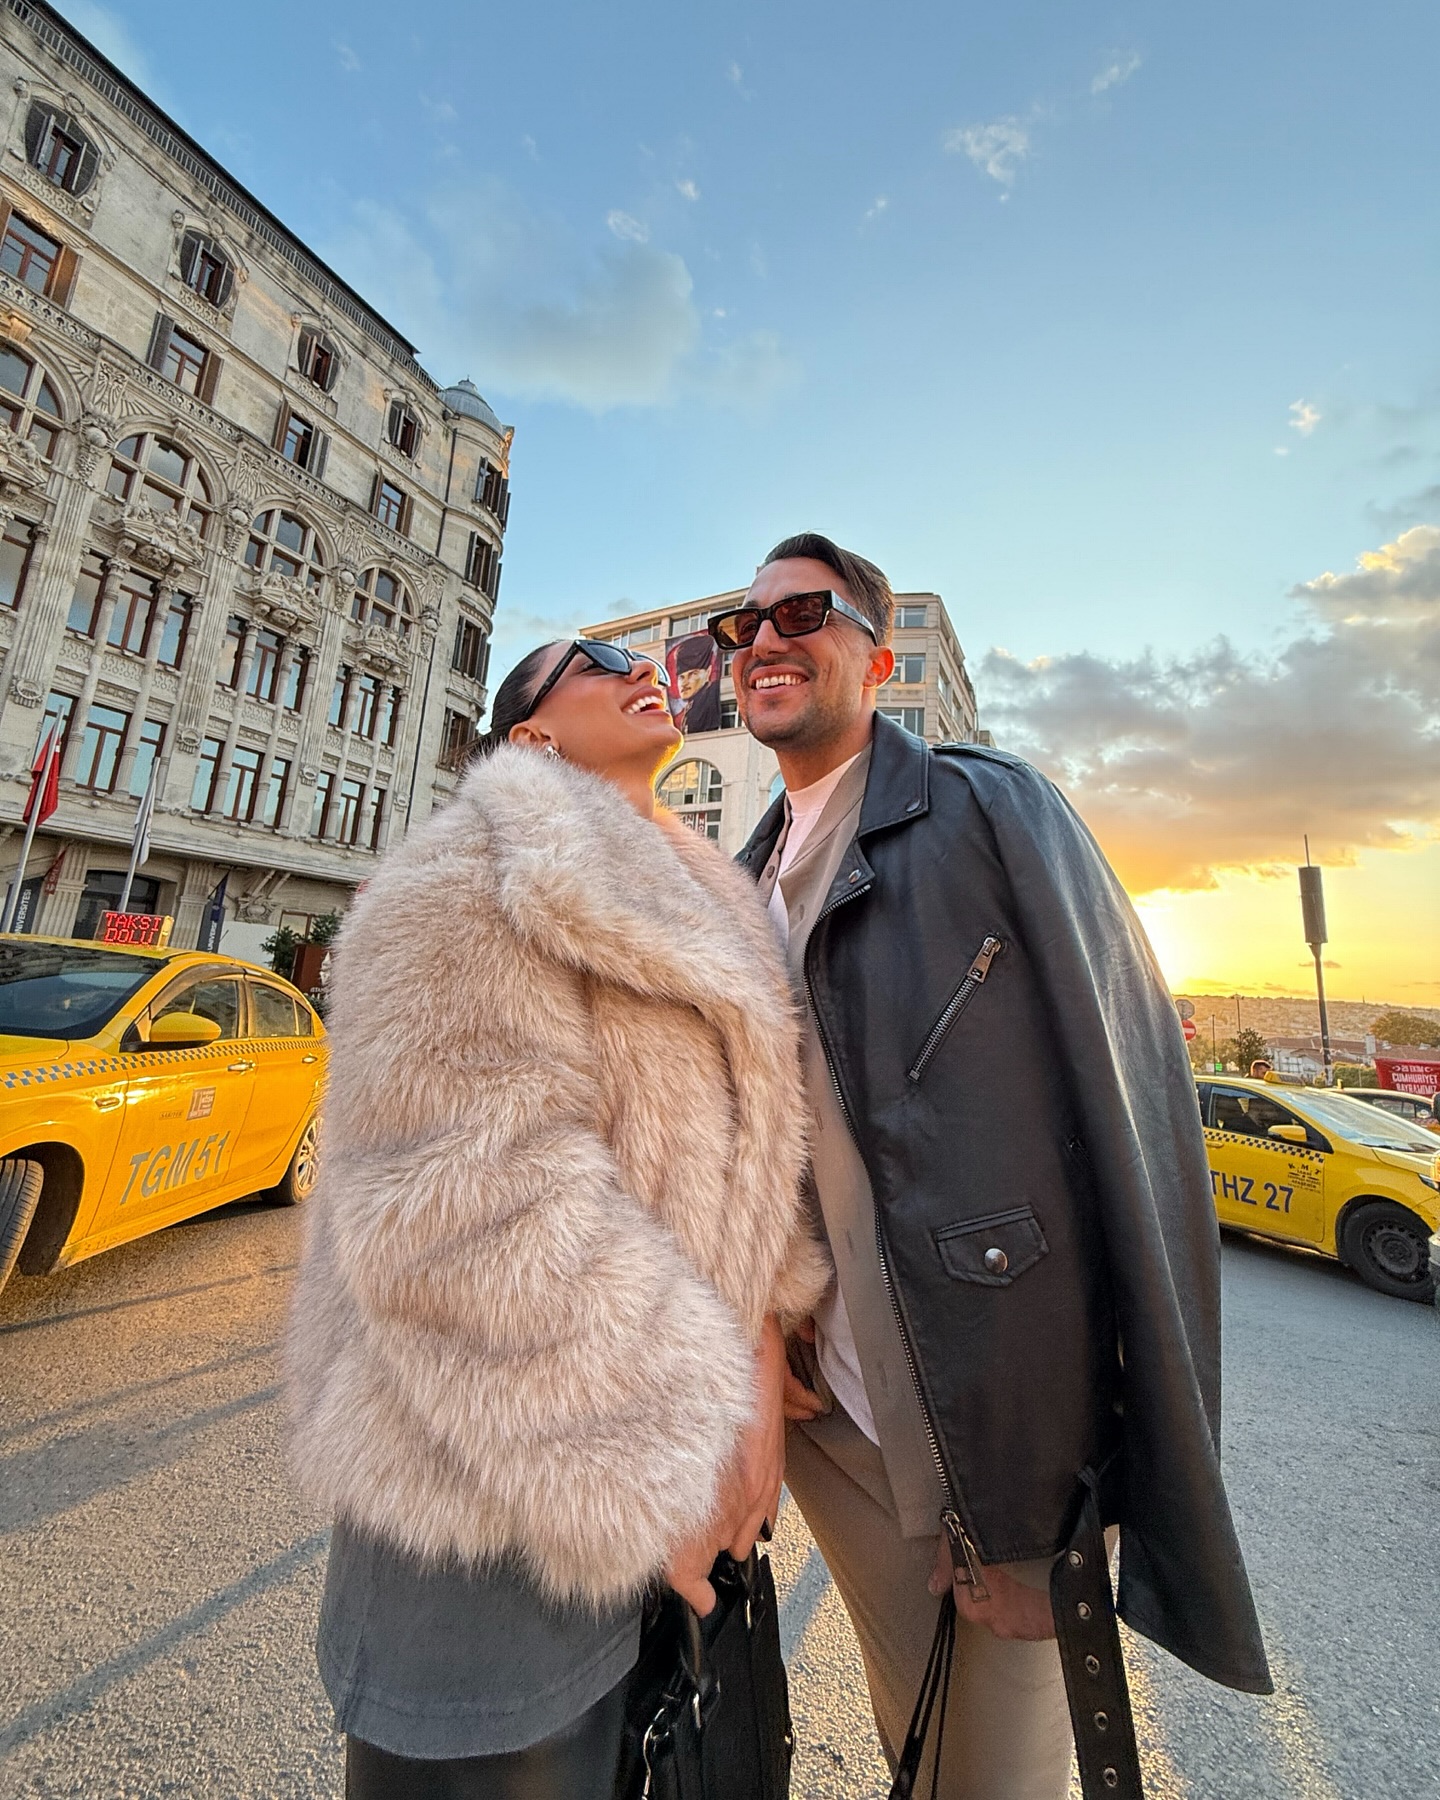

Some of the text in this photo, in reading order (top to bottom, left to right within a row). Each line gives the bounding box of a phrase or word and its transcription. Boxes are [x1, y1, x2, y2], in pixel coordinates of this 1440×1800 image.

[105, 912, 161, 931] TAKSI
[104, 928, 153, 944] DOLU
[1210, 1170, 1294, 1213] THZ 27
